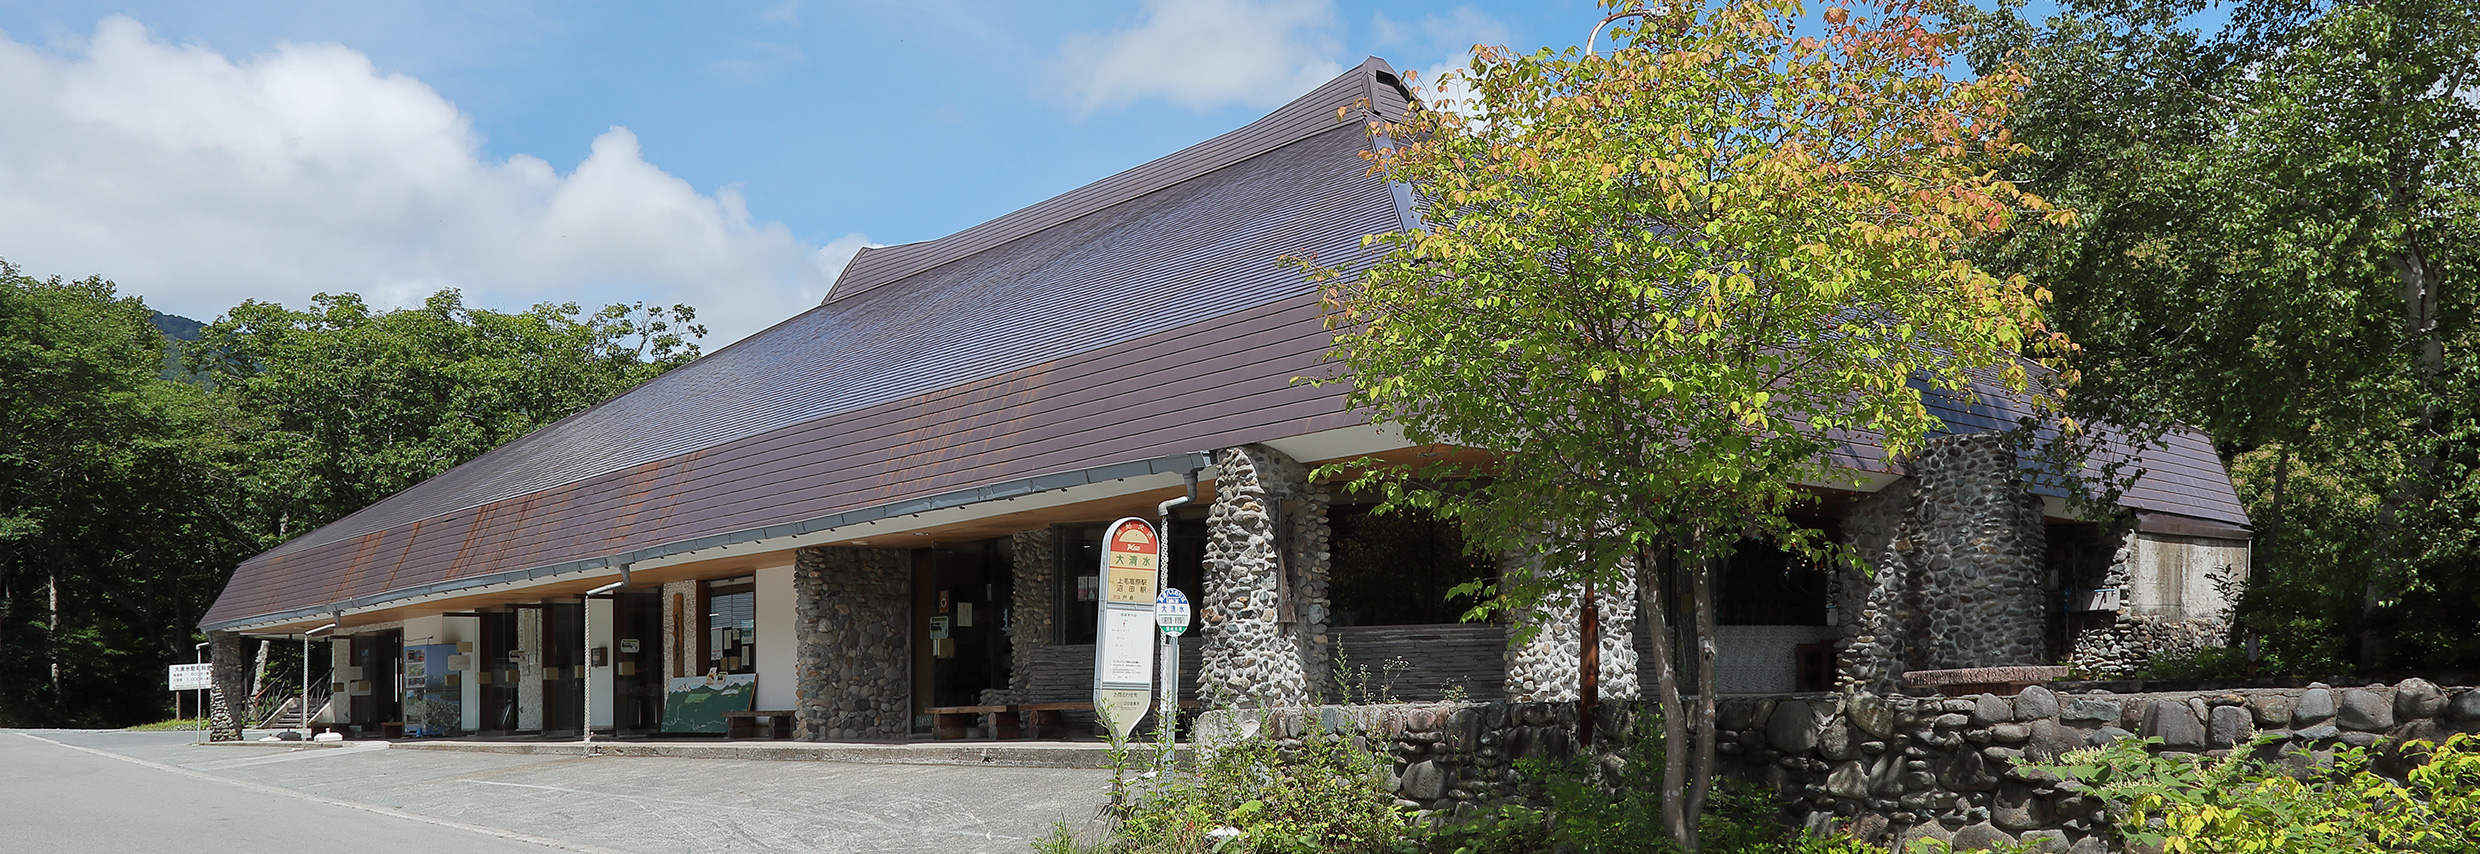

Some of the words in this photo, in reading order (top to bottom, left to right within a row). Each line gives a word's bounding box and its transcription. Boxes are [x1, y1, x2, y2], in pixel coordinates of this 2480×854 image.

[1115, 554, 1151, 566] 大清水
[1161, 605, 1185, 613] 大清水
